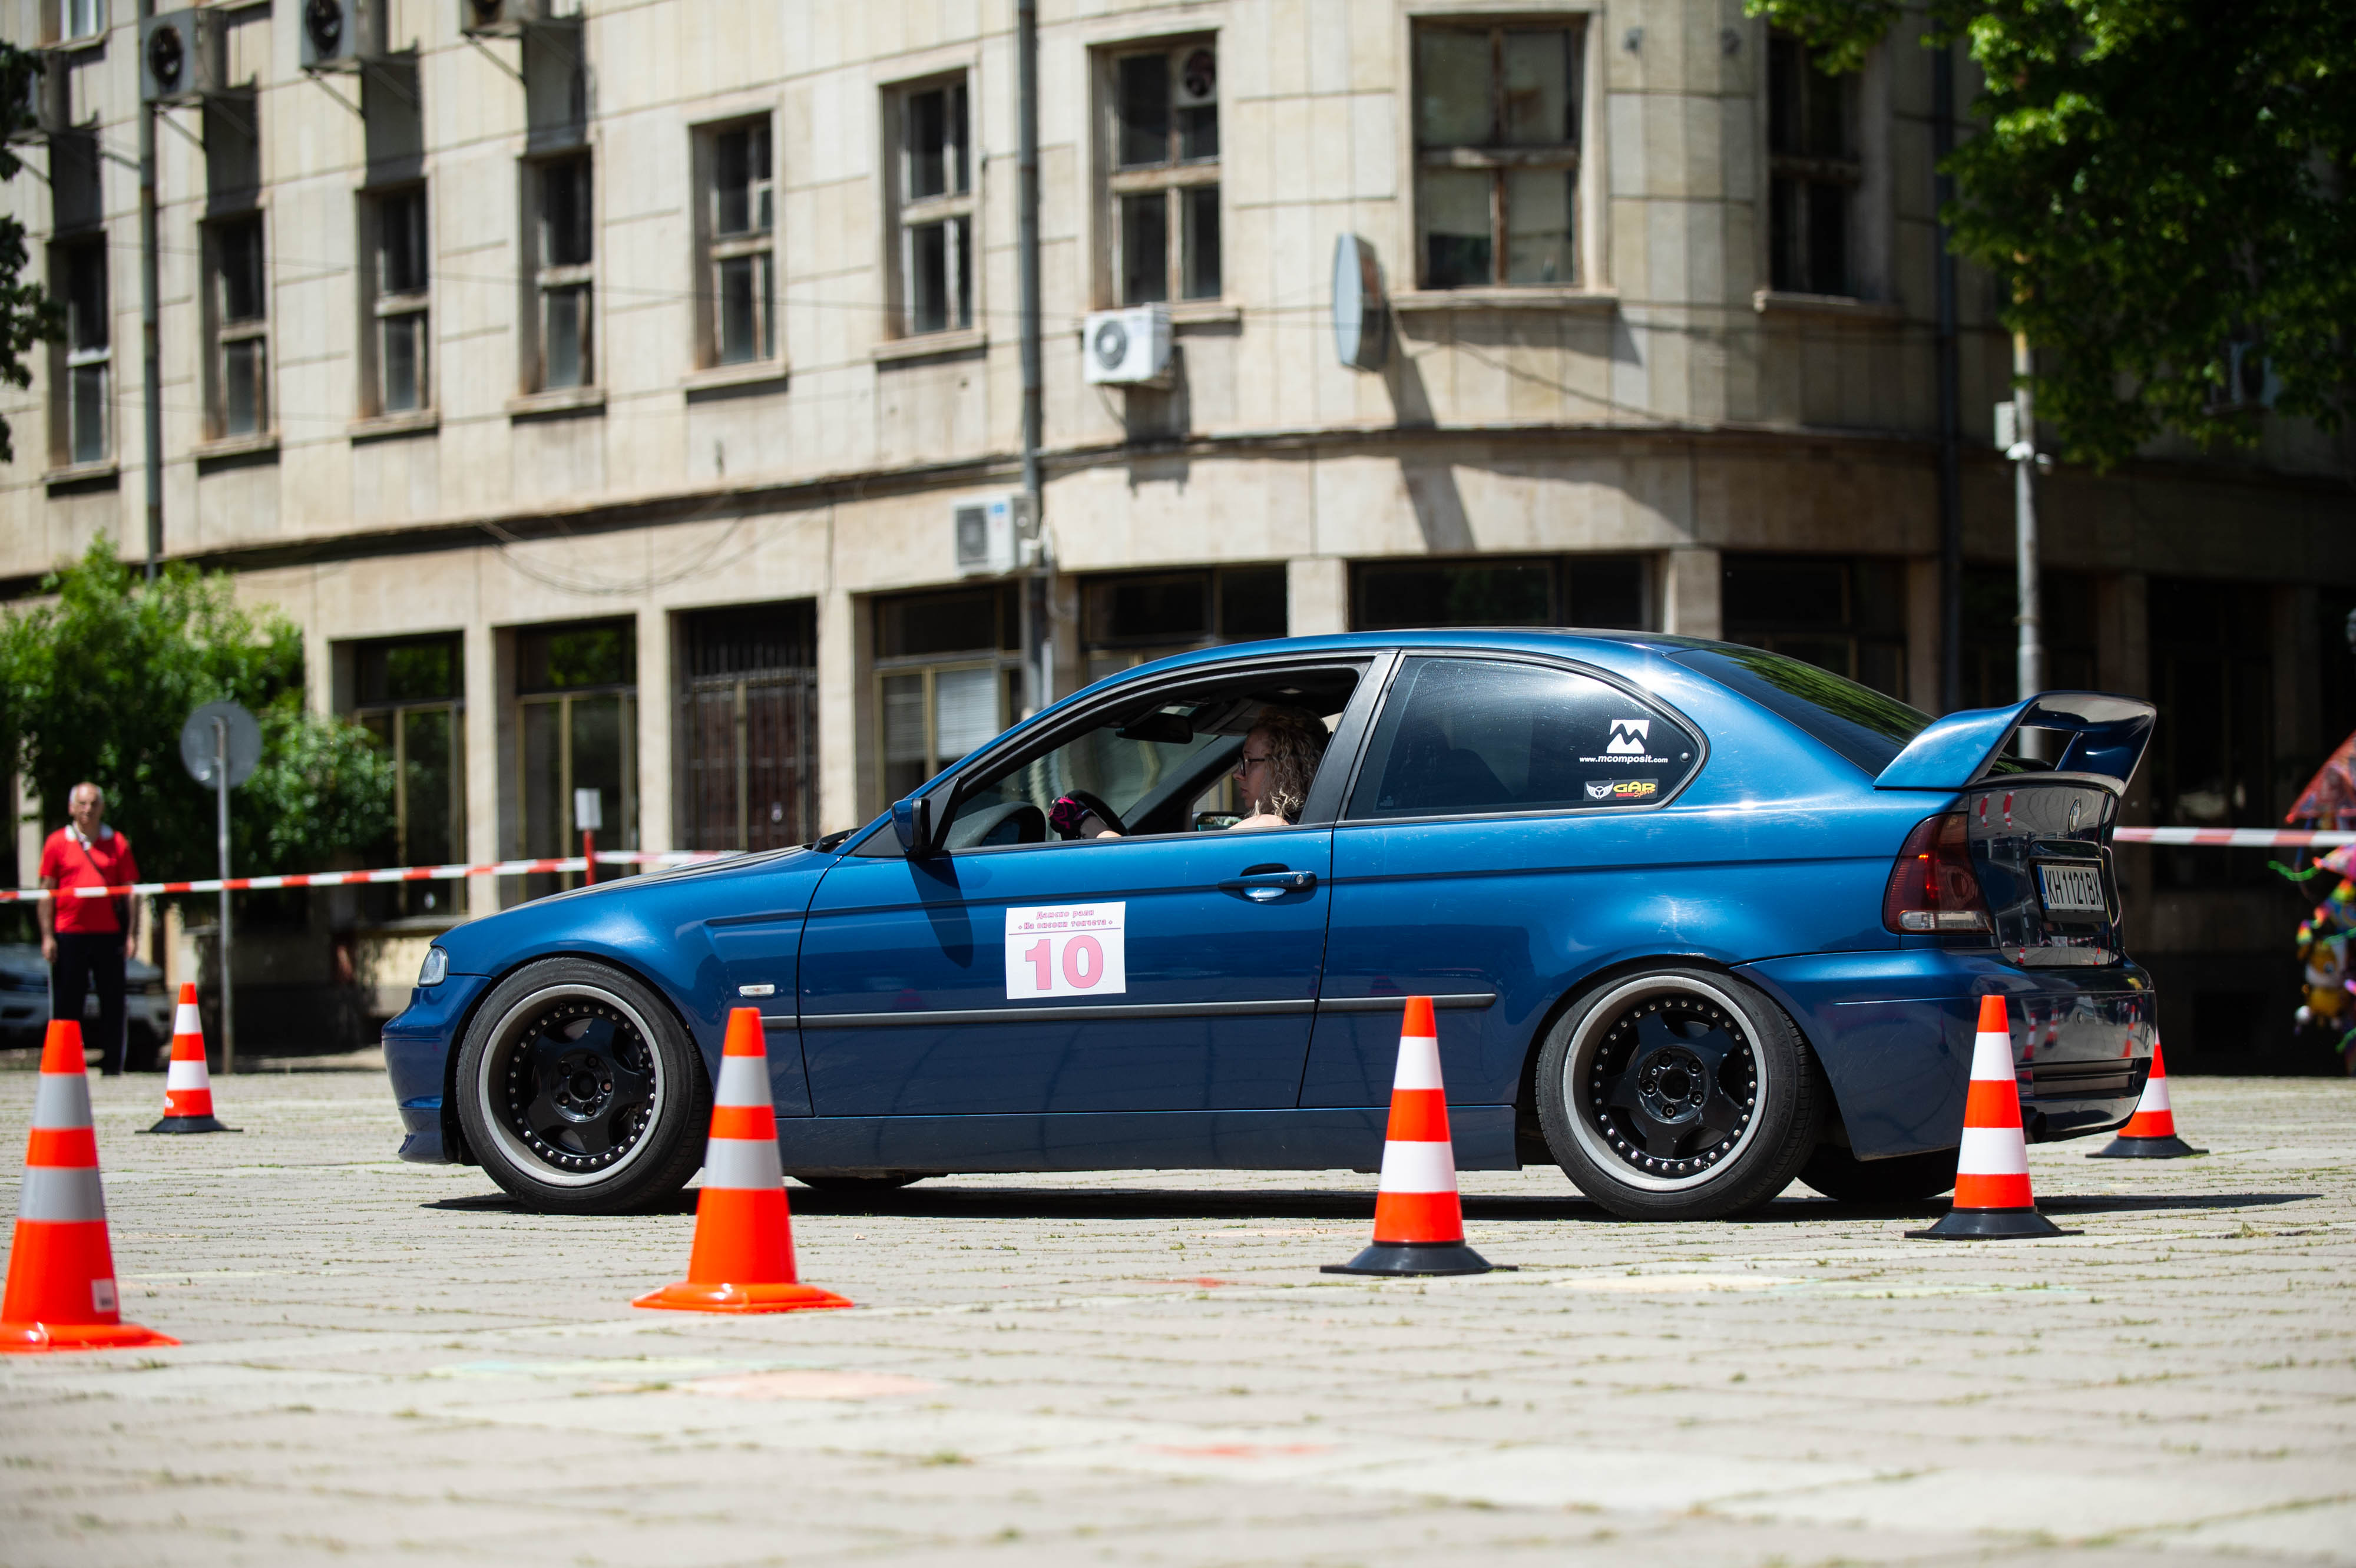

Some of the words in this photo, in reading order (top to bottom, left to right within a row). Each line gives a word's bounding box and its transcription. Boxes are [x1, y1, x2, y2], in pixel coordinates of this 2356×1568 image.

[1579, 755, 1669, 764] www.mcomposit.com
[1073, 909, 1094, 918] рали
[1025, 935, 1104, 991] 10
